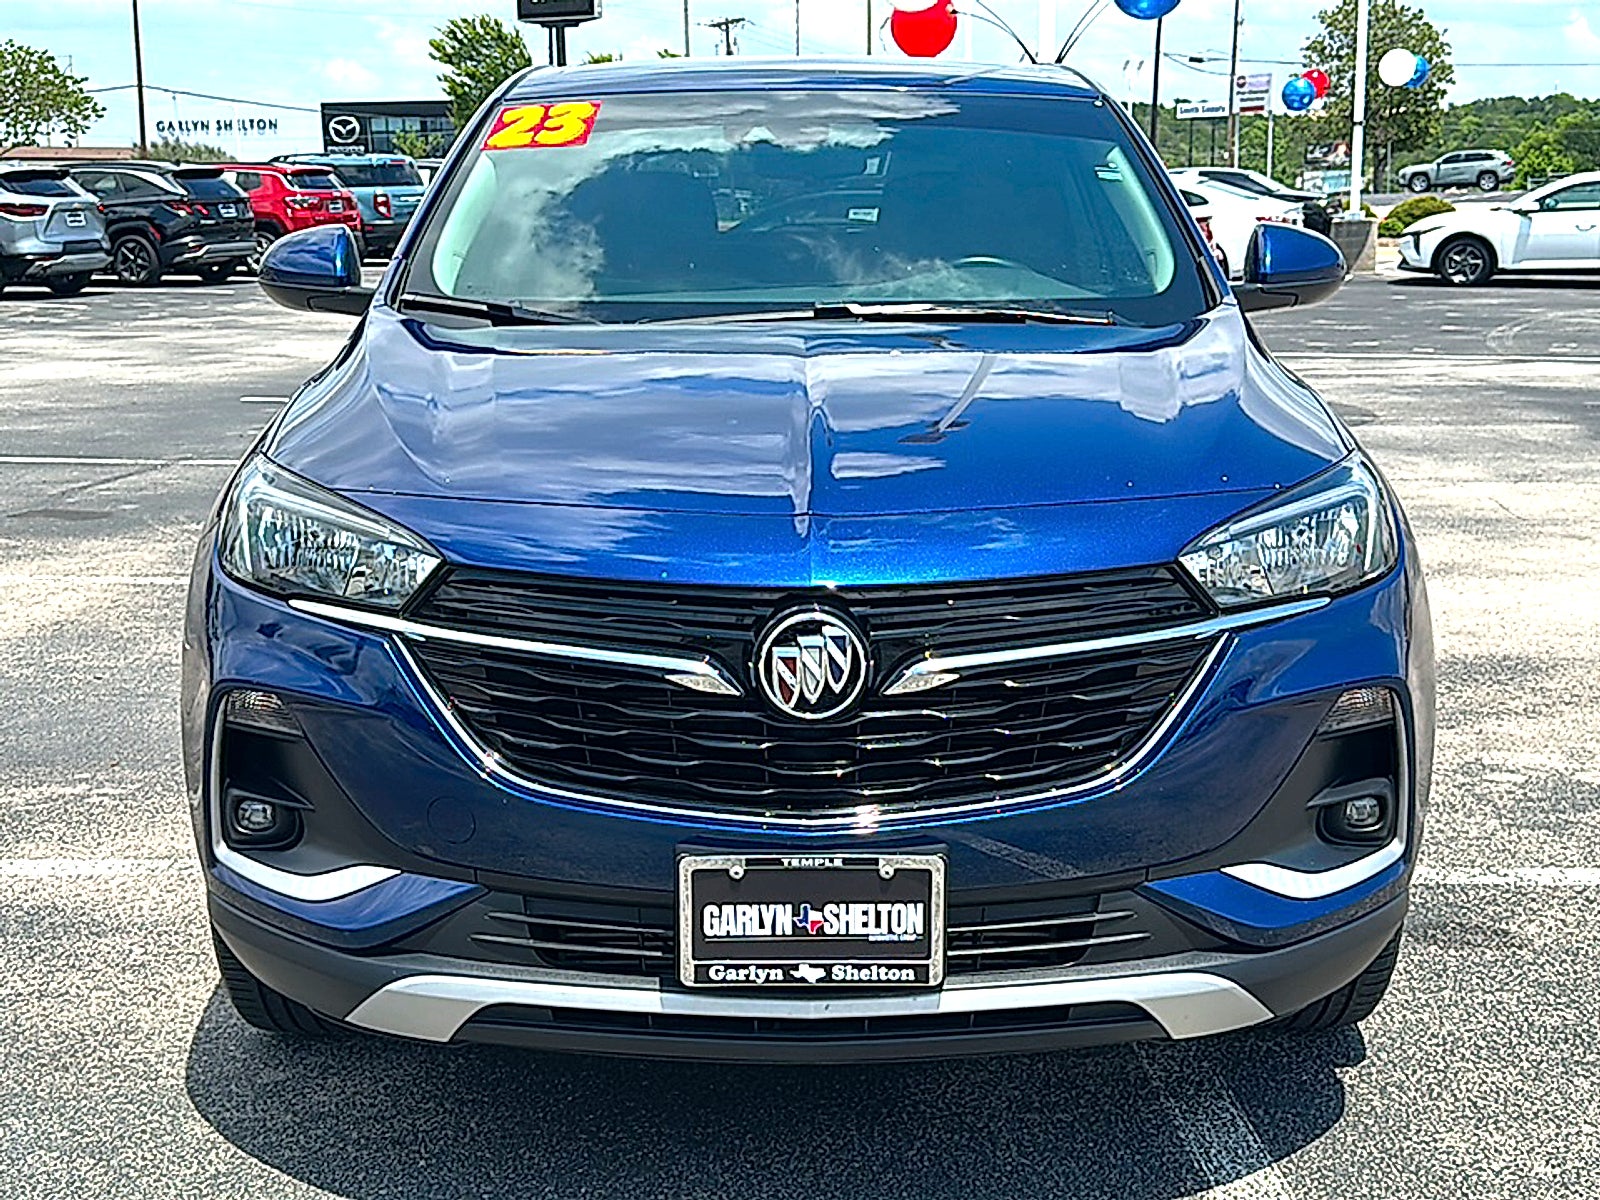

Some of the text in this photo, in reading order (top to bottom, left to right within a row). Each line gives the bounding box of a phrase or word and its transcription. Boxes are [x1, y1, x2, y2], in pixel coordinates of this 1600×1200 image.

[487, 102, 595, 147] 23
[781, 858, 843, 867] TEMPLE
[703, 903, 924, 936] GARLYN SHELTON
[708, 965, 916, 984] Garlyn Shelton
